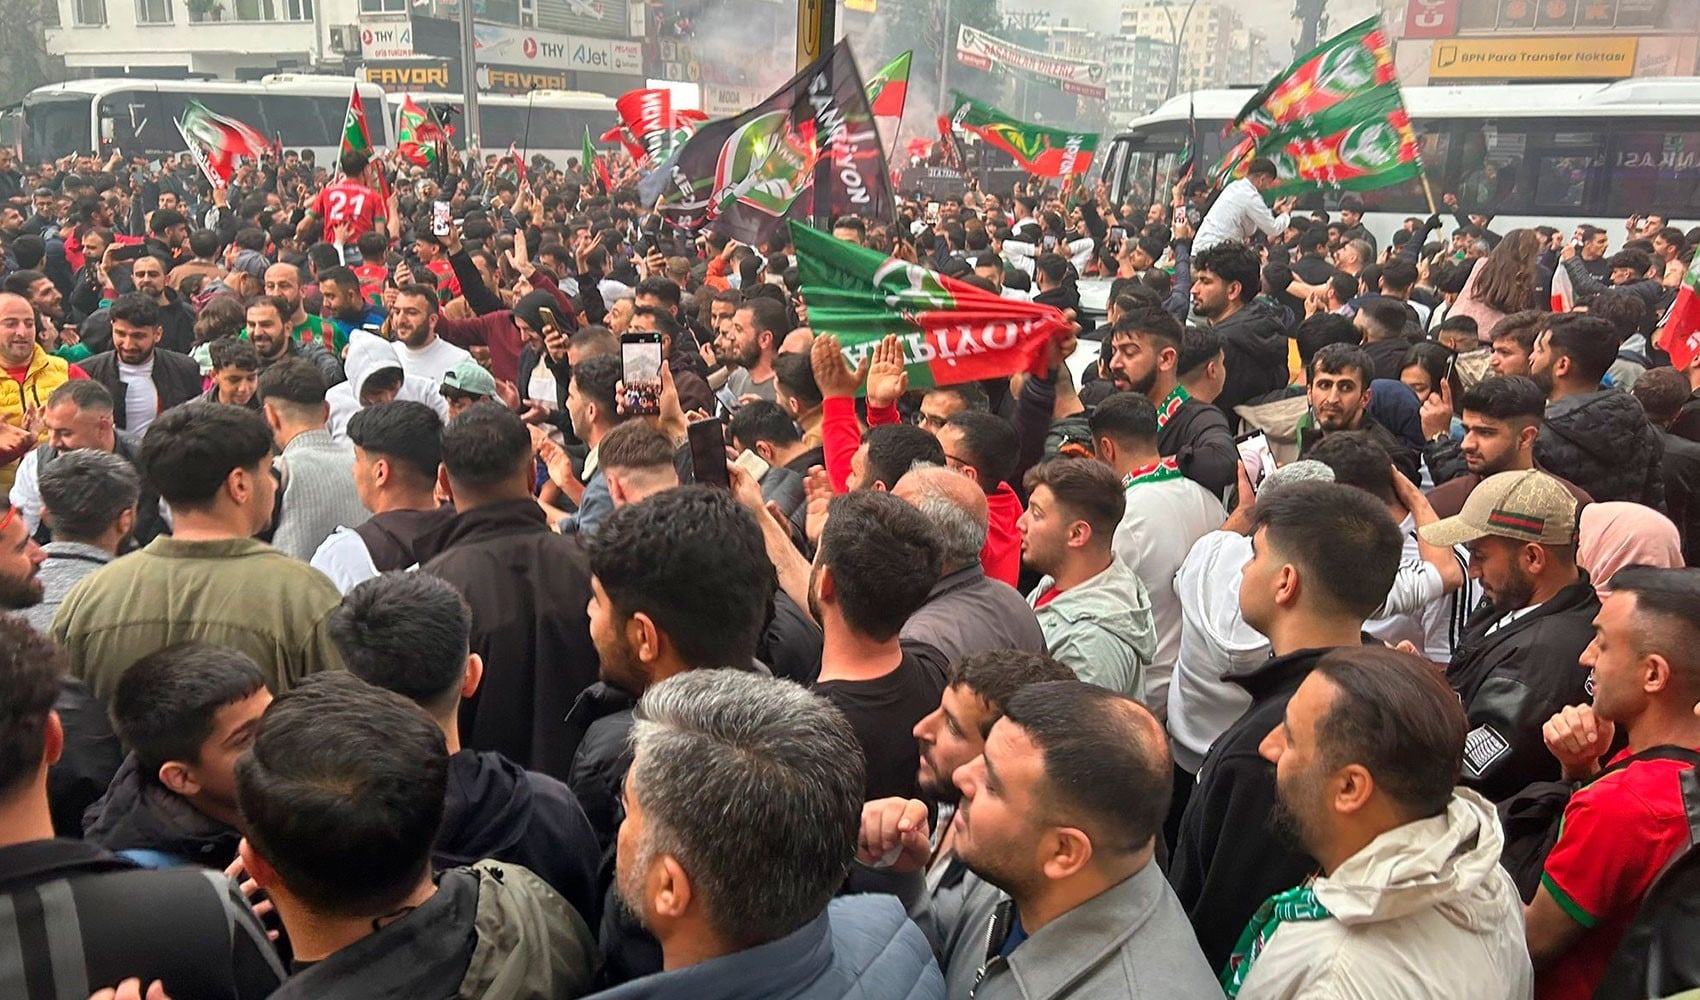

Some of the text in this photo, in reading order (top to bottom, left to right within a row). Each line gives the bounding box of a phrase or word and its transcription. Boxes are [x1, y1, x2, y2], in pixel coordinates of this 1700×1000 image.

[375, 31, 393, 43] THY
[540, 42, 564, 58] THY
[1461, 51, 1626, 63] BPN Para Transfer Noktası
[329, 190, 366, 220] 21
